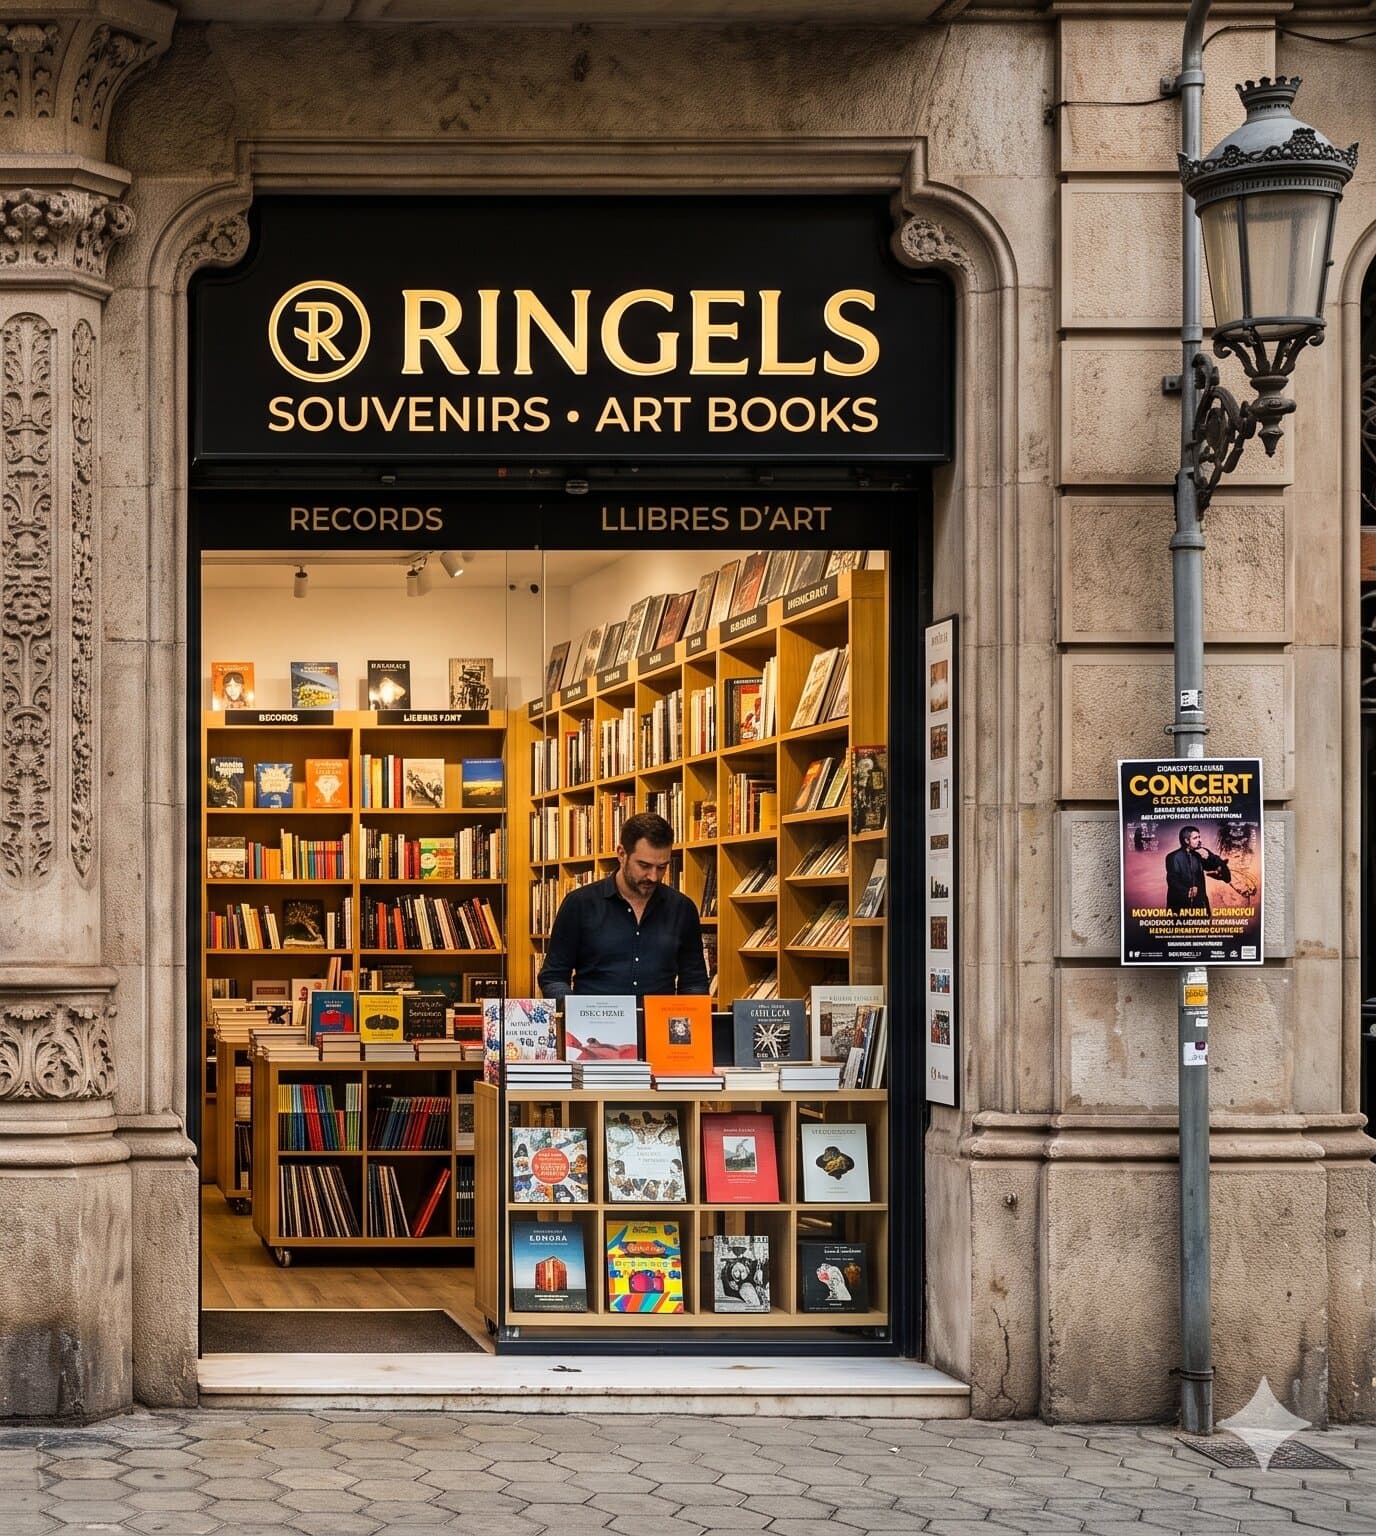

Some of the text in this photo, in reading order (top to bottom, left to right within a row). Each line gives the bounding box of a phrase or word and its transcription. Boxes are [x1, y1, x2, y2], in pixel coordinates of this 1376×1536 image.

[402, 289, 879, 376] RINGELS
[269, 397, 878, 432] SOUVENIRS ART BOOKS
[291, 508, 443, 531] RECORDS
[603, 507, 729, 530] LLIBRES
[1129, 773, 1253, 796] CONCERT
